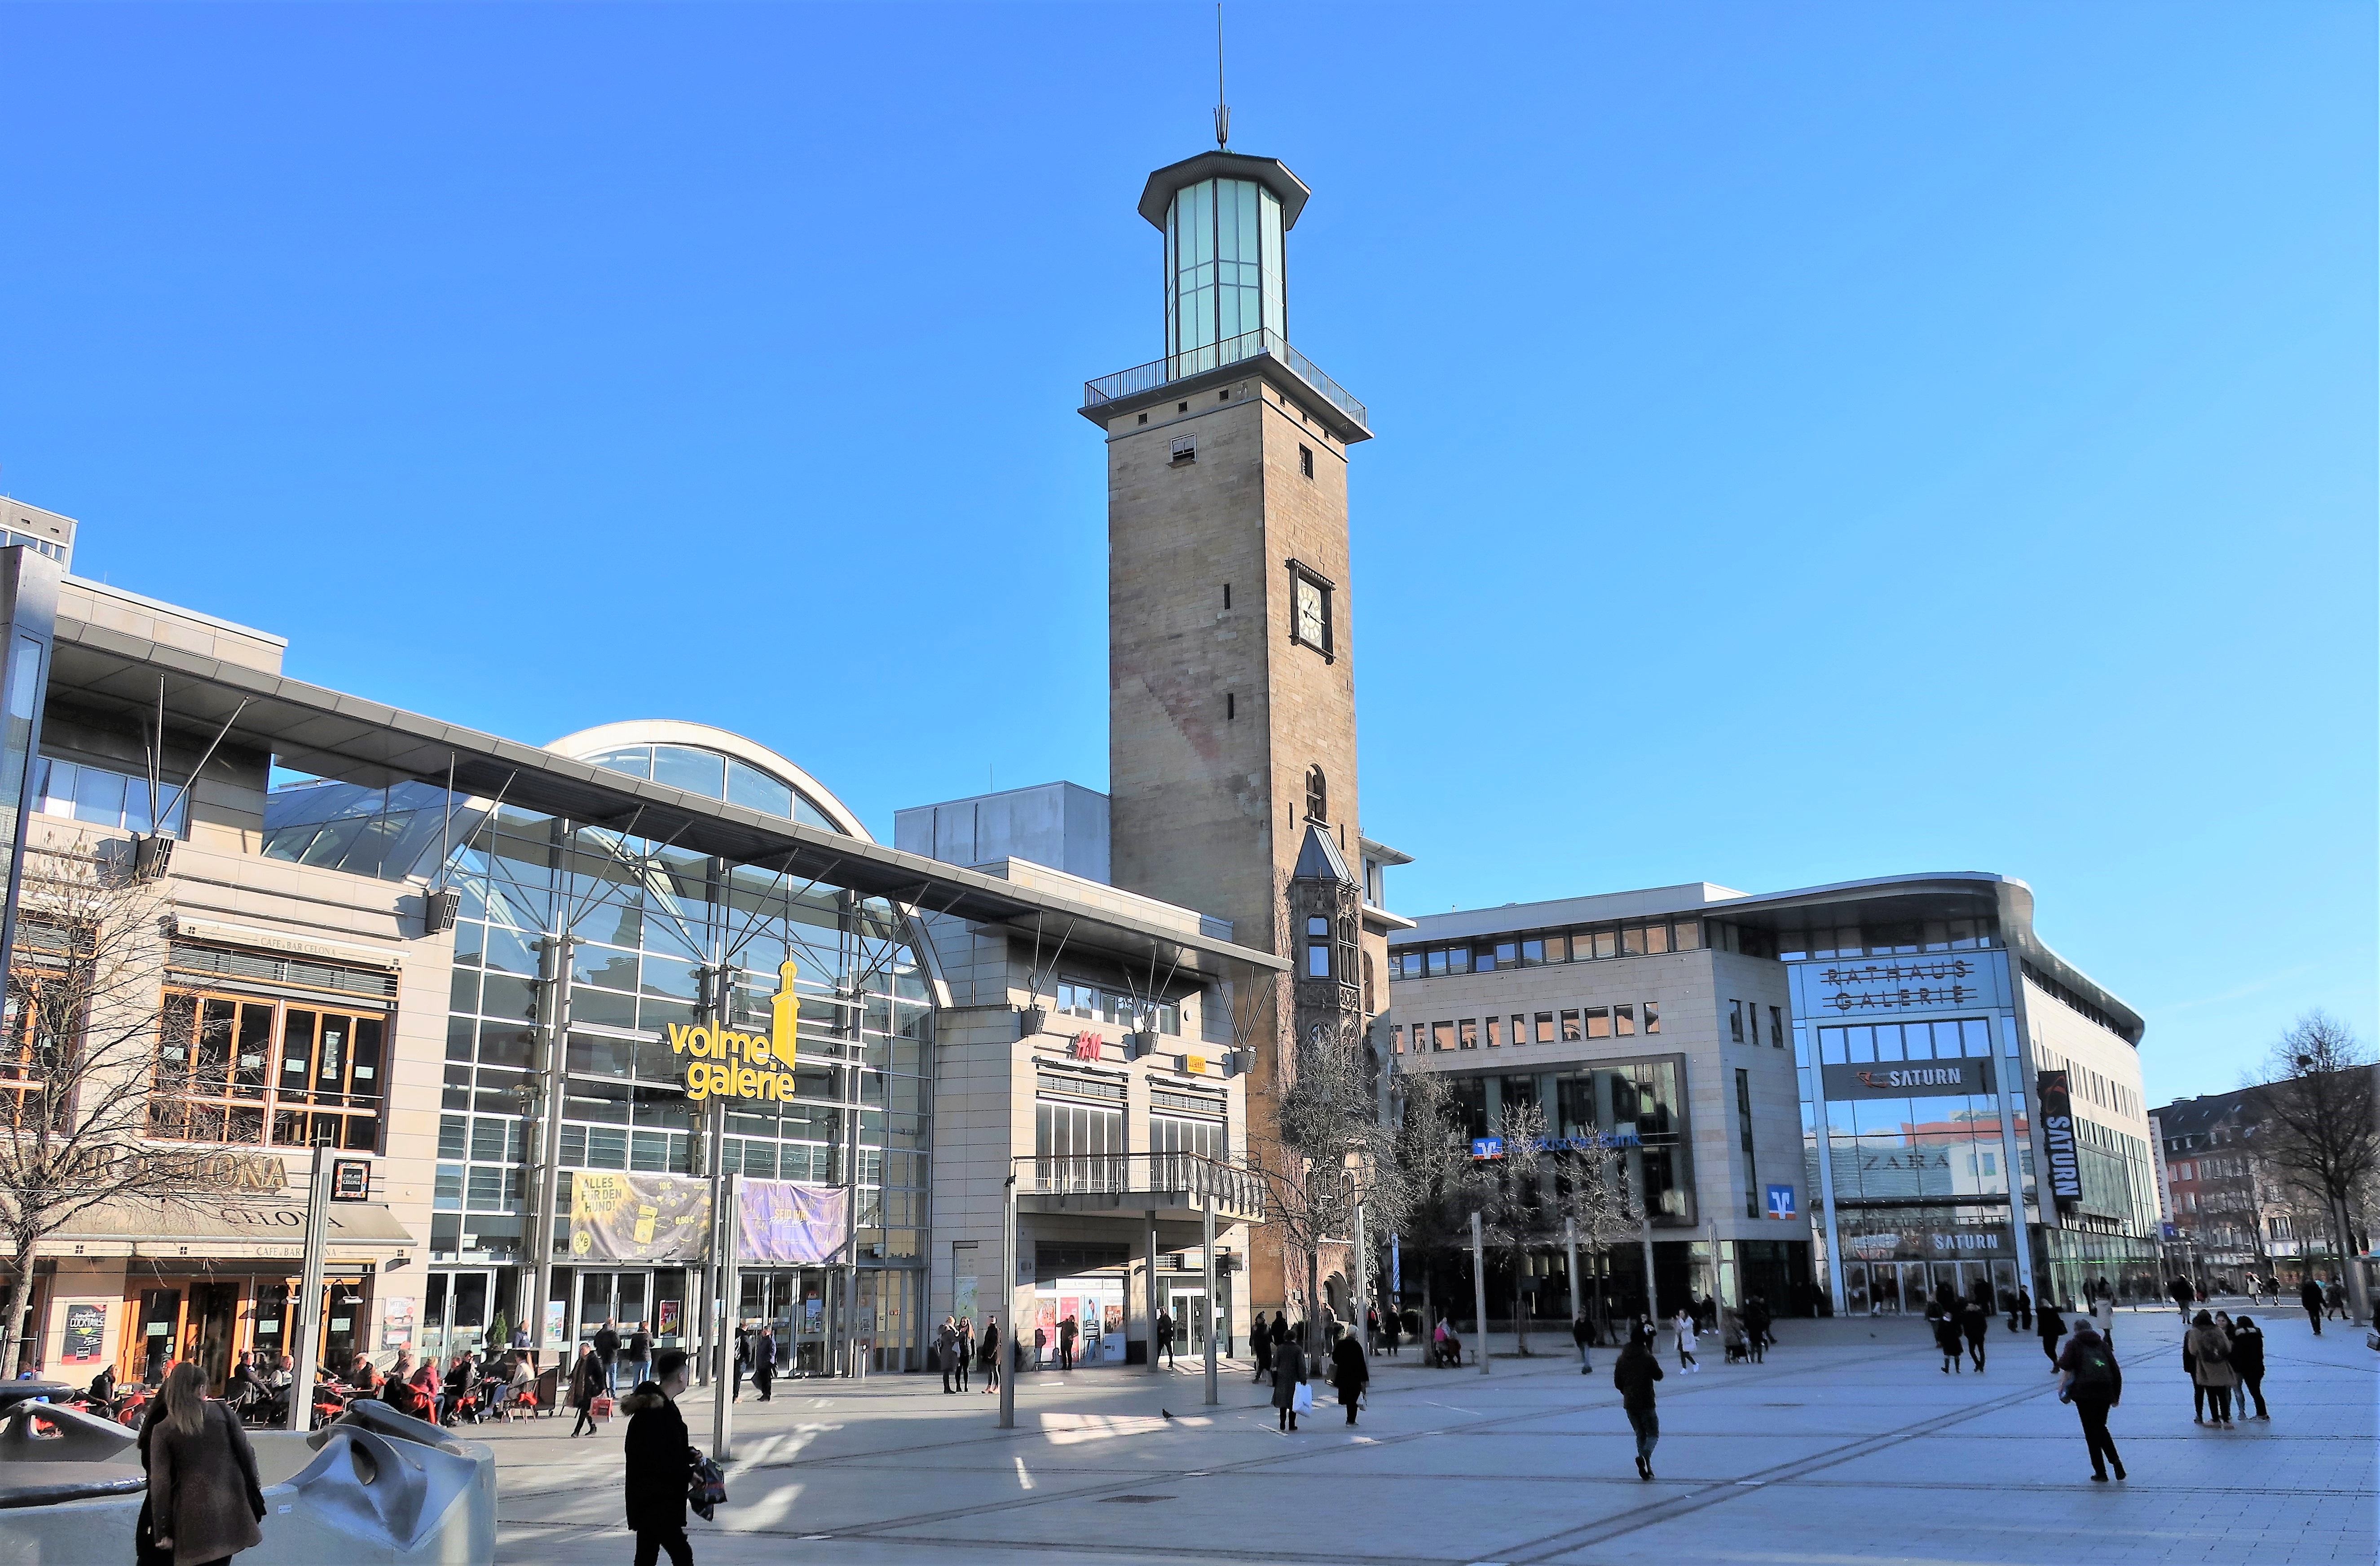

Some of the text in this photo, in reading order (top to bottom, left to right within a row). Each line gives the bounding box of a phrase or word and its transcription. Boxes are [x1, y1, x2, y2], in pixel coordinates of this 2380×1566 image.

[261, 938, 281, 948] CAFE
[286, 942, 302, 951] BAR
[304, 944, 336, 956] CELONA
[1828, 960, 1967, 985] RATHAUS
[1835, 985, 1964, 1010] GALERIE
[667, 1019, 771, 1065] volme
[1076, 1030, 1102, 1062] H&M
[1188, 1056, 1205, 1069] Netto
[687, 1056, 795, 1103] galerie
[1890, 1068, 1962, 1087] SATURN
[1508, 1129, 1641, 1152] rkische Bank
[1864, 1155, 1950, 1170] ZARA
[2046, 1116, 2079, 1196] SATURN
[583, 1178, 613, 1189] ALLES
[581, 1189, 621, 1201] FÜR DEN
[585, 1201, 615, 1213] HUND!
[576, 1233, 588, 1247] BVB
[1933, 1234, 1998, 1250] SATURN
[256, 1247, 278, 1256] CAFE
[284, 1247, 300, 1257] BAR
[70, 1318, 104, 1328] COCKTAILS
